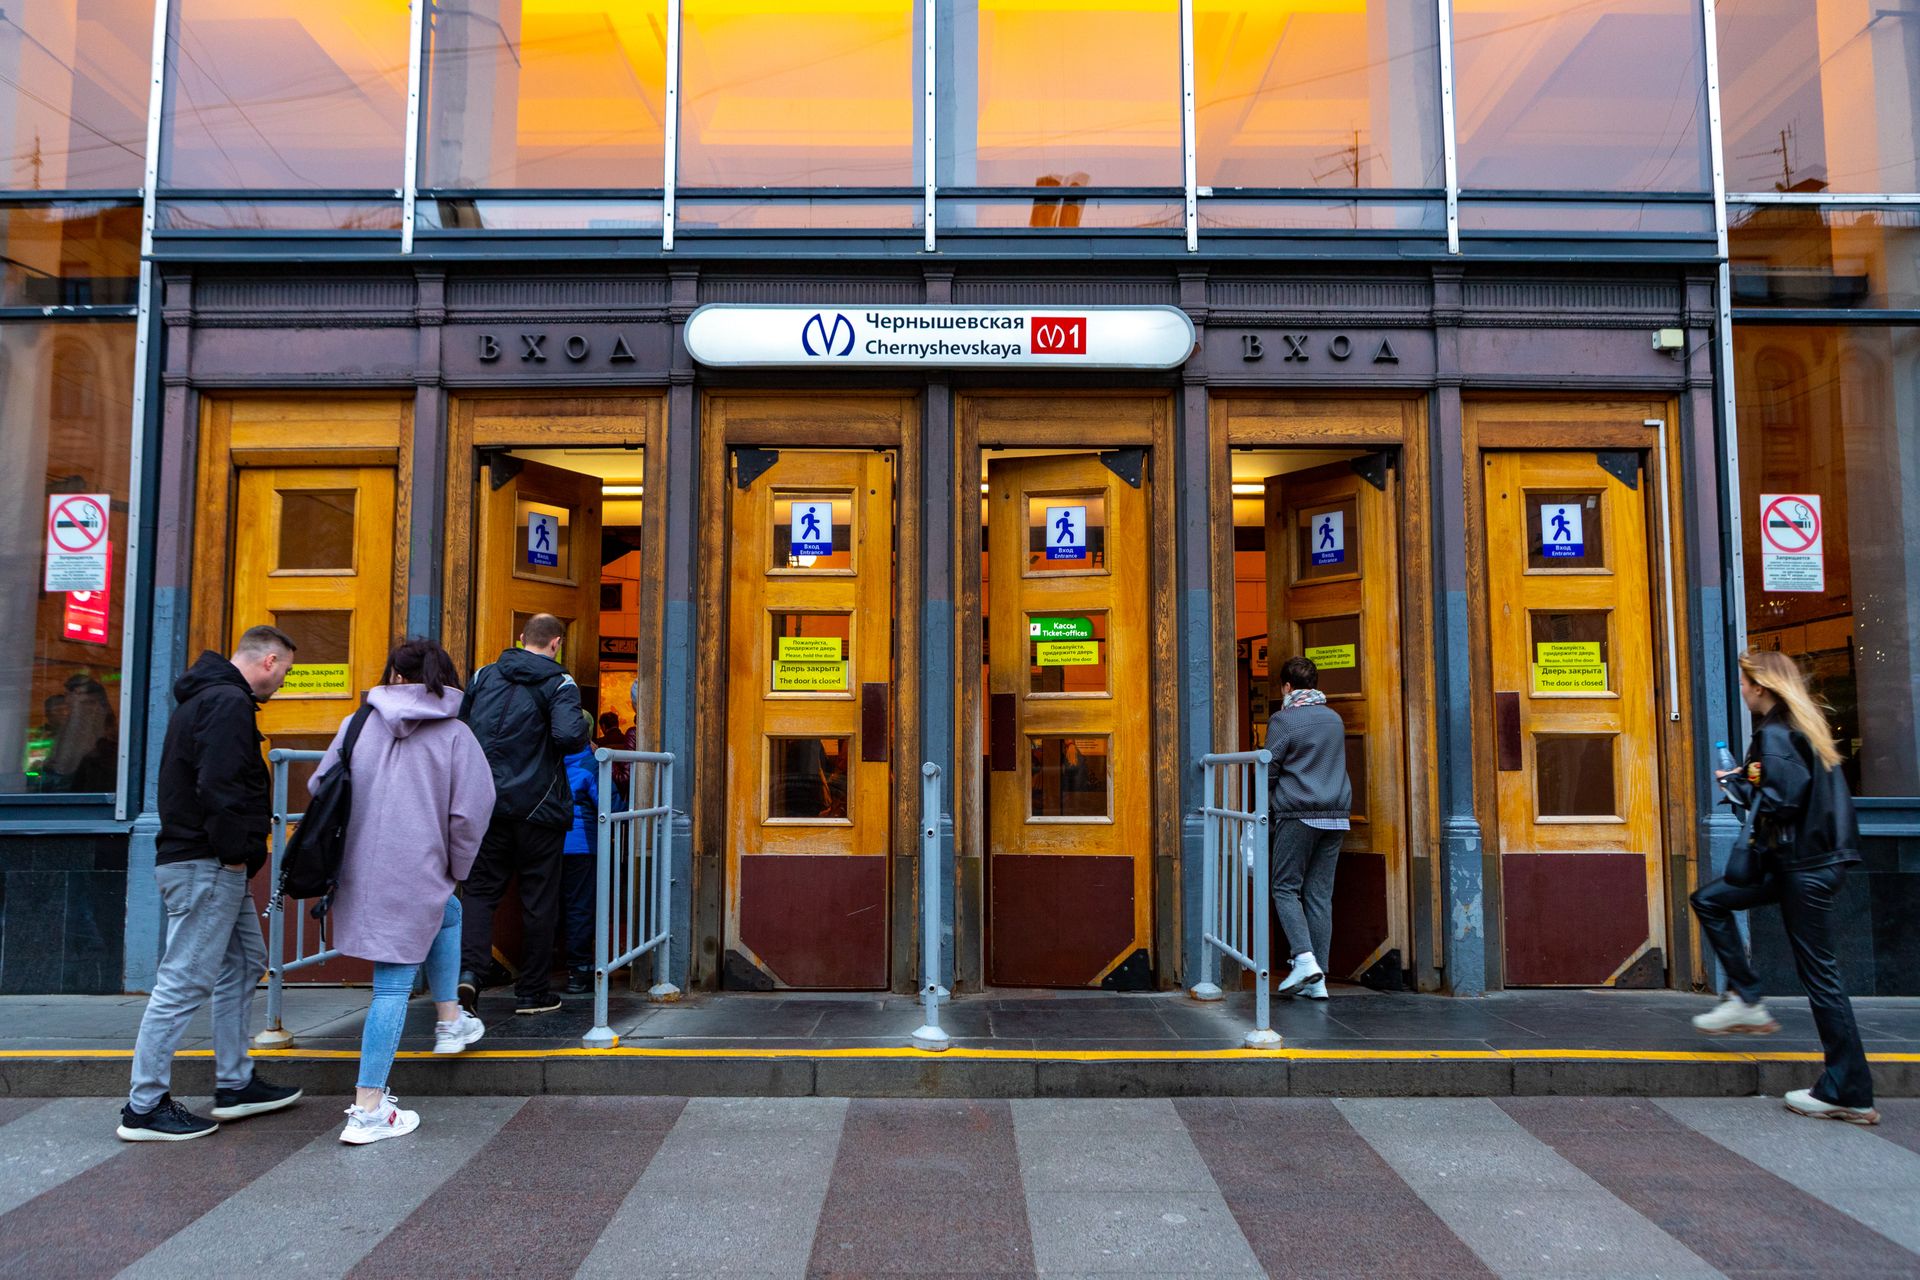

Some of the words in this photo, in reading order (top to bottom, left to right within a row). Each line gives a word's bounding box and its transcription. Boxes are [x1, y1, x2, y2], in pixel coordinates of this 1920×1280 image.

[866, 312, 1024, 332] Чернышевская
[479, 333, 636, 363] ВХОД
[866, 339, 1022, 359] Chernyshevskaya
[1242, 335, 1399, 364] ВХОД
[804, 543, 820, 551] Вход
[1058, 547, 1074, 555] Вход
[1555, 544, 1572, 552] Вход
[1053, 622, 1077, 630] Кассы
[1042, 629, 1088, 637] Ticket-offices
[311, 669, 344, 677] закрыта
[780, 665, 805, 673] Дверь
[1541, 667, 1567, 675] Дверь
[1580, 679, 1603, 687] closed
